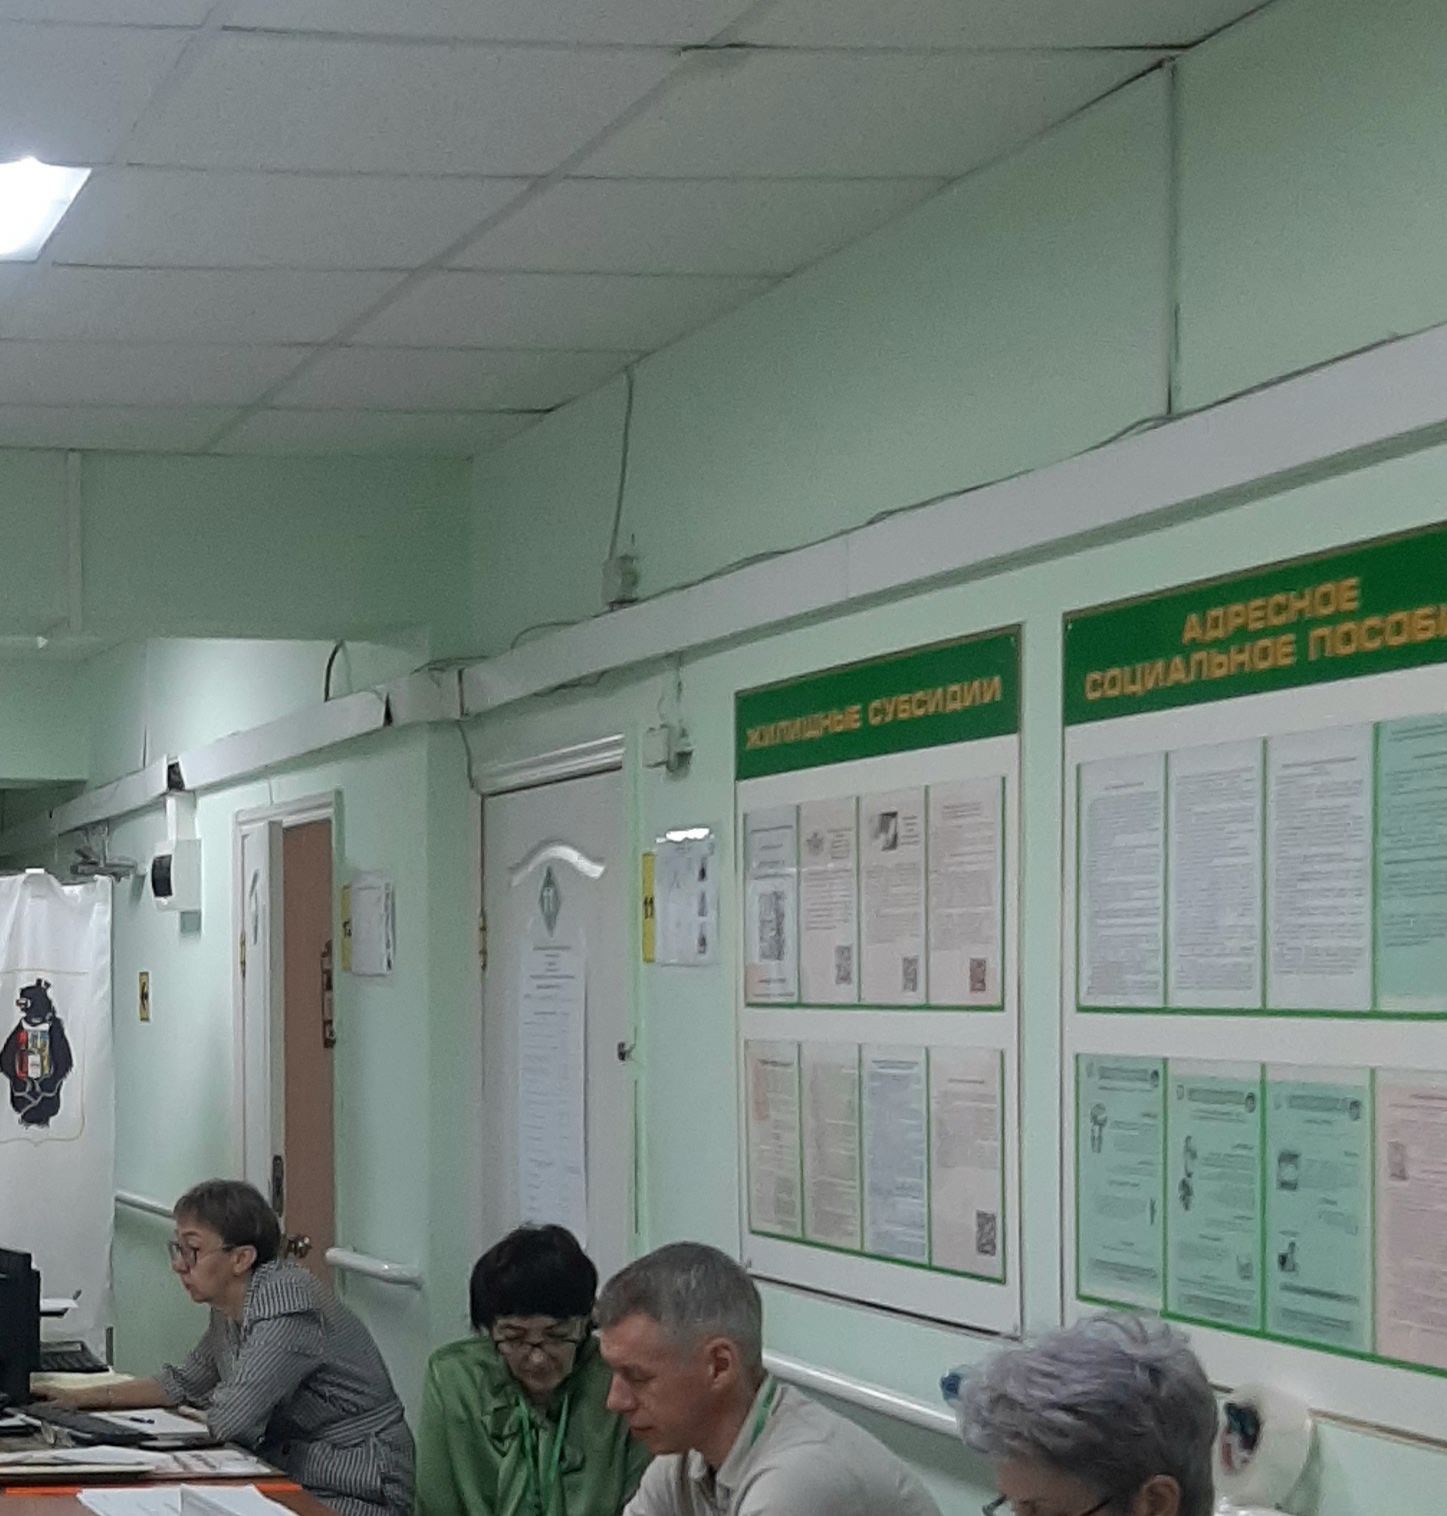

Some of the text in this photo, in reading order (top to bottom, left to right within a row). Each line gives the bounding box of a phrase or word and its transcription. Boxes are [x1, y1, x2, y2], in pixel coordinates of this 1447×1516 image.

[1182, 577, 1359, 644] АДРЕСНОЕ
[1085, 633, 1296, 700] СОЦИАЛЬНОЕ
[868, 675, 1001, 726] СУБСИДИИ
